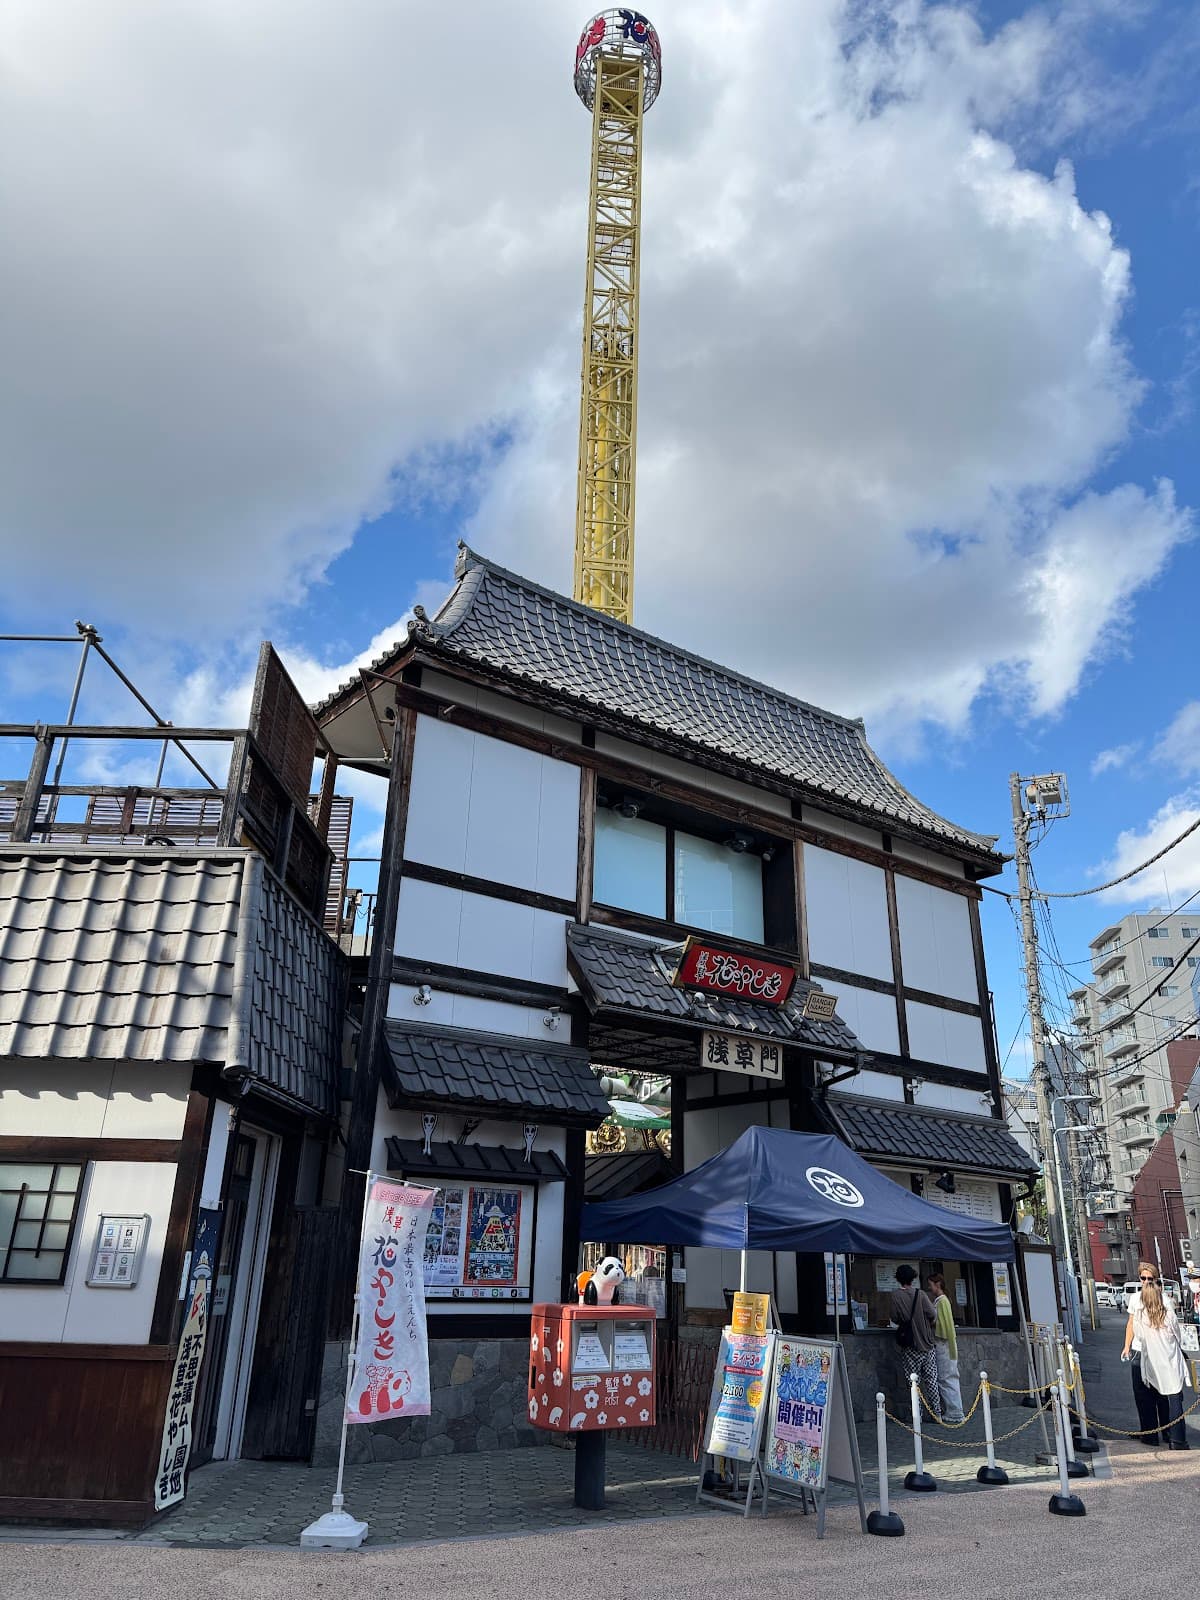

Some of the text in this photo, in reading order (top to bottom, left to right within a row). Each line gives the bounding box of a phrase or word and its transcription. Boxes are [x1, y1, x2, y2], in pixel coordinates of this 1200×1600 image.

[705, 955, 782, 999] 花やしき
[809, 1003, 832, 1014] NAMCO
[812, 997, 834, 1008] BANDAI
[382, 1205, 404, 1233] 浅草
[403, 1216, 418, 1342] 日本最古のゆうえんち
[370, 1235, 399, 1361] 花やしき
[605, 1396, 619, 1405] POST
[778, 1400, 823, 1432] 開催中!
[159, 1334, 193, 1500] 浅草花やしき
